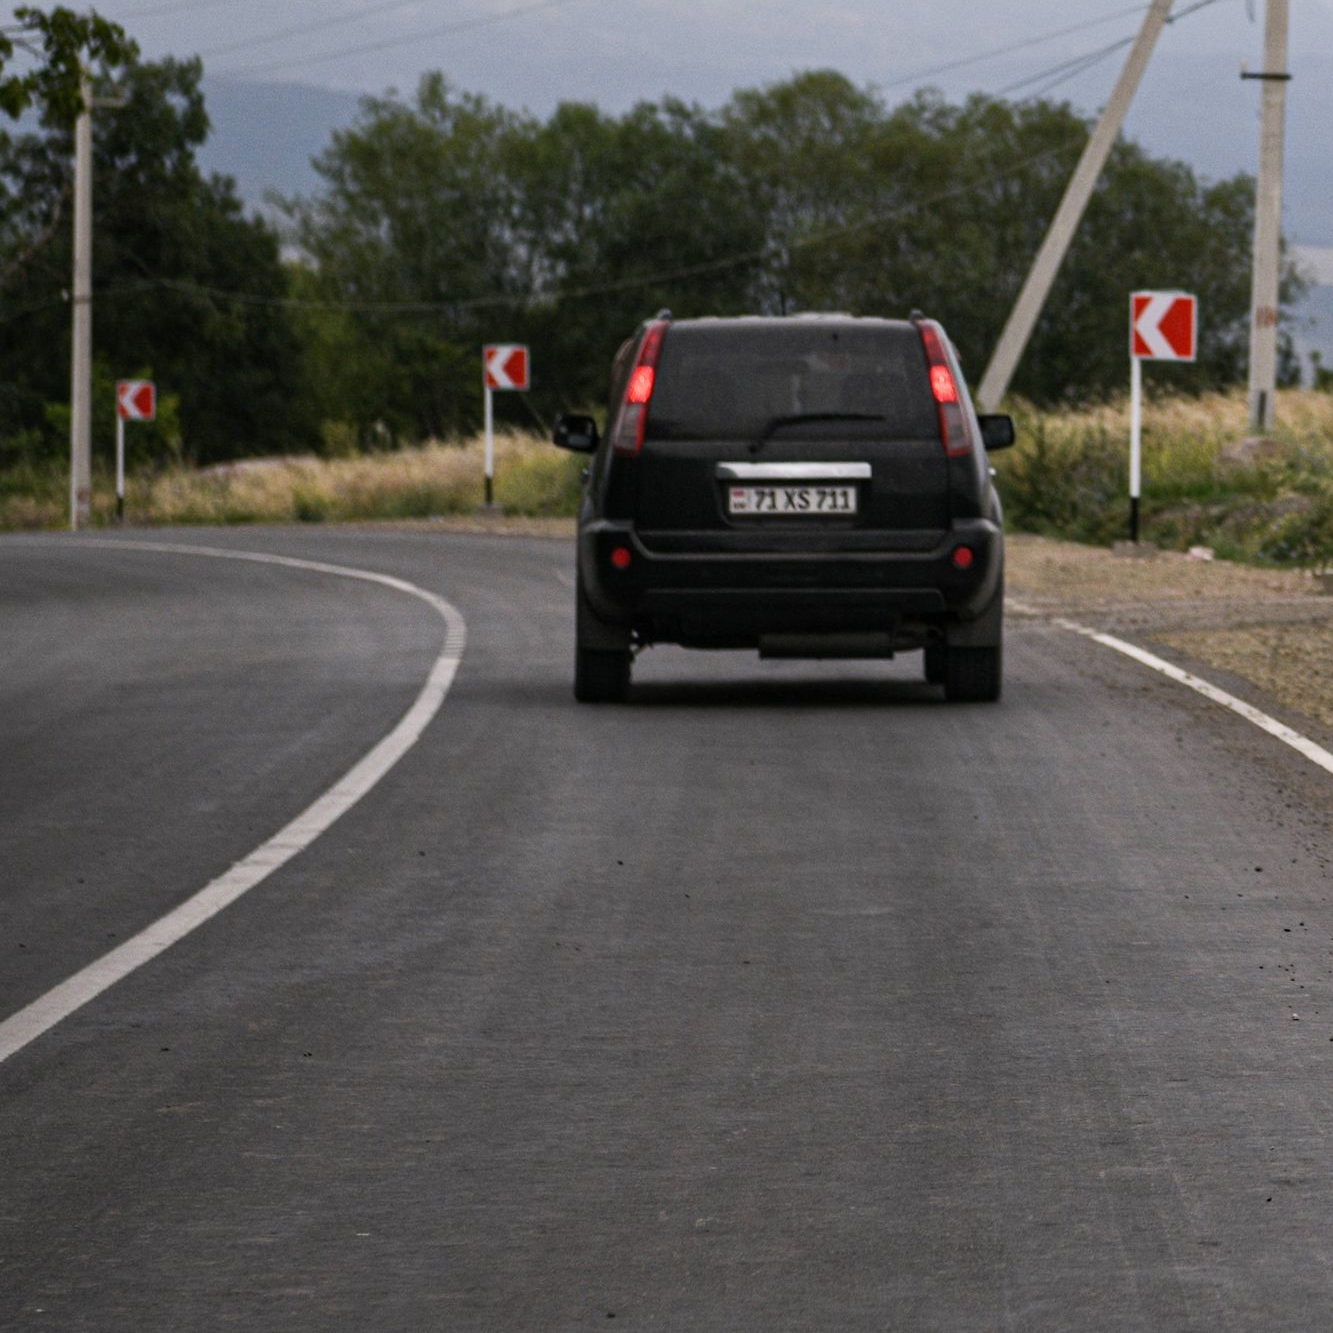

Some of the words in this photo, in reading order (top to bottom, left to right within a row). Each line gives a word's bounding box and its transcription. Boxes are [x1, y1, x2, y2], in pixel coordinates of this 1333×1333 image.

[756, 490, 776, 509] 71
[784, 490, 810, 509] XS
[817, 490, 849, 509] 711
